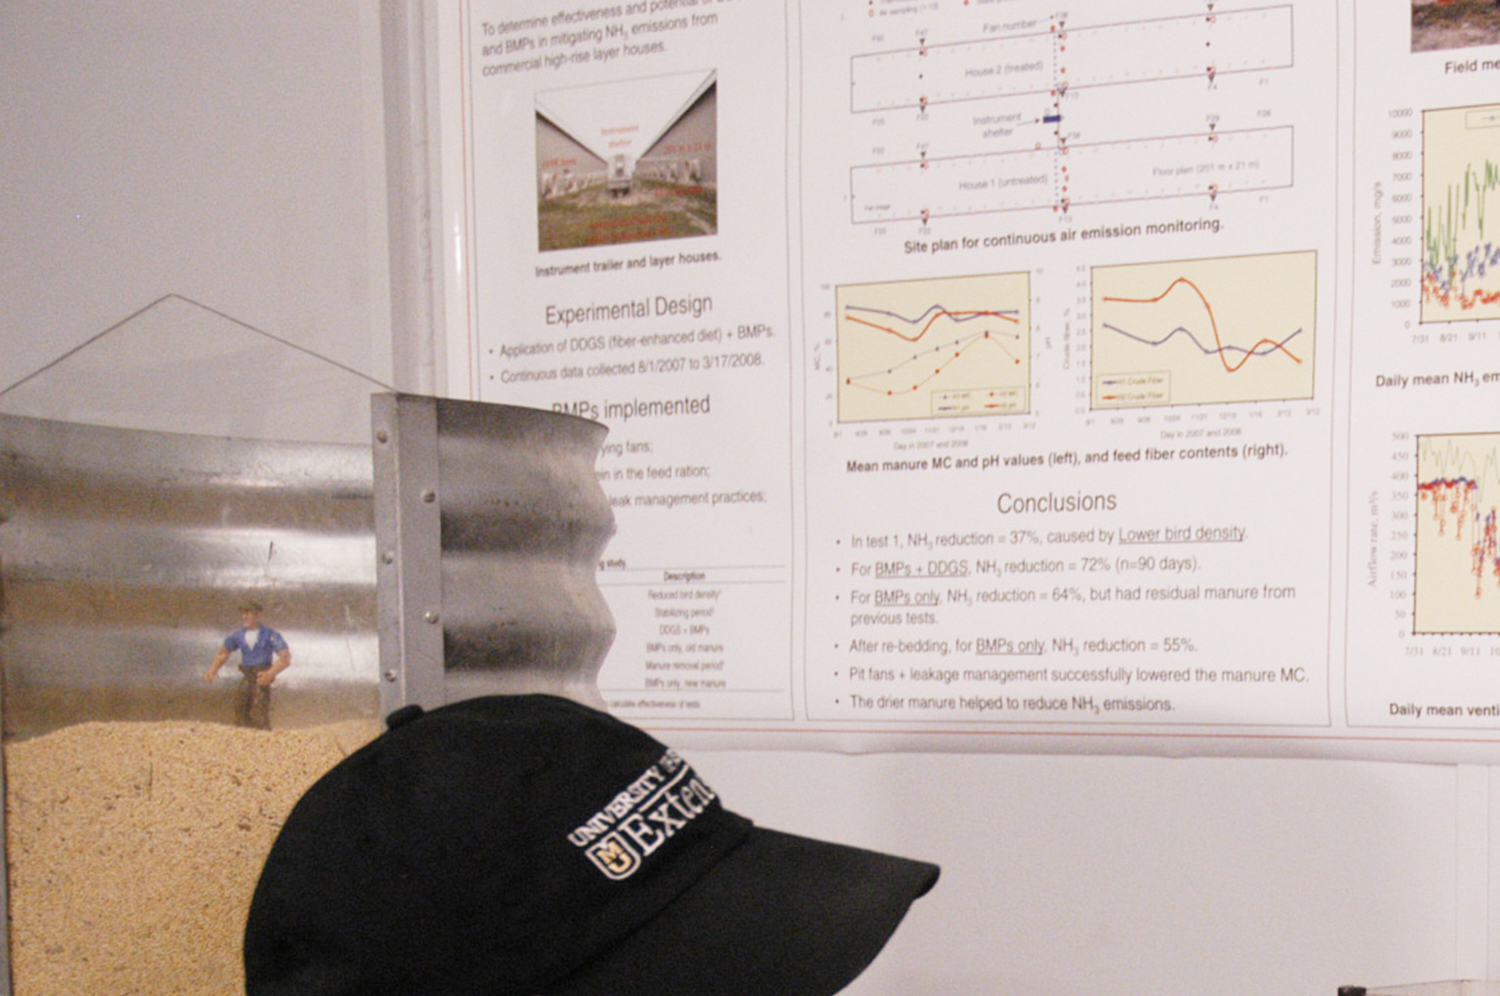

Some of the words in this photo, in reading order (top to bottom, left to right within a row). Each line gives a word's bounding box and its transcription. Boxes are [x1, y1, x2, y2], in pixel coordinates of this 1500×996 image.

[482, 43, 503, 56] and
[505, 37, 535, 53] BMPs
[538, 36, 547, 47] in
[550, 28, 602, 46] mitigating
[631, 17, 688, 35] emissions
[692, 13, 718, 27] from
[482, 60, 542, 76] commercial
[544, 52, 591, 69] high-rise
[594, 48, 620, 64] layer
[1444, 60, 1478, 74] Field
[904, 240, 928, 254] Site
[931, 236, 959, 254] plan
[962, 235, 979, 249] for
[983, 229, 1057, 247] continuous
[1060, 228, 1077, 241] air
[1081, 223, 1141, 240] emission
[1145, 218, 1225, 234] monitoring.
[535, 263, 591, 277] Instrument
[593, 260, 623, 272] trailer
[626, 257, 647, 268] and
[649, 255, 675, 268] layer
[545, 298, 650, 327] Experimental
[655, 295, 713, 318] Design
[500, 341, 554, 358] Application
[557, 340, 567, 351] of
[570, 336, 606, 351] DDGS
[608, 331, 695, 351] (fiber-enhanced
[697, 328, 723, 342] diet)
[737, 324, 776, 339] BMPs.
[501, 367, 558, 383] Continuous
[560, 364, 584, 379] data
[586, 361, 635, 377] collected
[689, 358, 699, 370] to
[1375, 374, 1408, 389] Daily
[1412, 372, 1450, 385] mean
[604, 395, 711, 421] implemented
[846, 460, 879, 473] Mean
[882, 459, 928, 471] manure
[932, 457, 952, 469] MC
[955, 455, 979, 468] and
[982, 455, 1000, 469] pH
[1003, 453, 1045, 466] values
[1085, 450, 1109, 464] and
[1112, 448, 1140, 462] feed
[1145, 447, 1175, 460] fiber
[1179, 445, 1239, 459] contents
[1242, 444, 1288, 458] (right).
[626, 468, 644, 479] the
[647, 466, 672, 478] feed
[635, 492, 709, 508] management
[997, 491, 1117, 514] Conclusions
[851, 535, 863, 548] In
[866, 534, 889, 548] test
[935, 531, 994, 547] reduction
[1010, 529, 1043, 545] 37%,
[1047, 529, 1094, 543] caused
[1098, 528, 1115, 545] by
[1119, 527, 1161, 544] Lower
[1165, 526, 1191, 541] bird
[851, 562, 871, 576] For
[875, 561, 911, 576] BMPs
[1004, 558, 1064, 574] reduction
[1081, 558, 1111, 572] 72%
[850, 590, 871, 604] For
[874, 589, 910, 605] BMPs
[976, 587, 1035, 603] reduction
[1052, 586, 1085, 602] 64%,
[1090, 587, 1111, 601] but
[1115, 587, 1141, 600] had
[1145, 586, 1200, 600] residual
[1204, 587, 1259, 600] manure
[1263, 585, 1296, 599] from
[850, 612, 902, 627] previous
[906, 612, 938, 625] tests.
[849, 639, 878, 654] After
[956, 638, 972, 652] for
[976, 638, 1013, 652] BMPs
[1083, 637, 1145, 652] reduction
[1163, 637, 1198, 652] 55%.
[849, 667, 865, 681] Pit
[868, 667, 895, 681] fans
[910, 667, 960, 684] leakage
[963, 668, 1048, 685] management
[1051, 667, 1132, 684] successfully
[1136, 667, 1191, 682] lowered
[1195, 667, 1217, 681] the
[1221, 668, 1276, 682] manure
[1280, 668, 1310, 683] MC.
[850, 695, 874, 709] The
[877, 695, 904, 708] drier
[908, 696, 956, 709] manure
[959, 695, 1003, 712] helped
[1006, 697, 1019, 710] to
[1023, 696, 1068, 711] reduce
[1103, 697, 1175, 712] emissions.
[1389, 702, 1422, 718] Daily
[1426, 704, 1463, 716] mean
